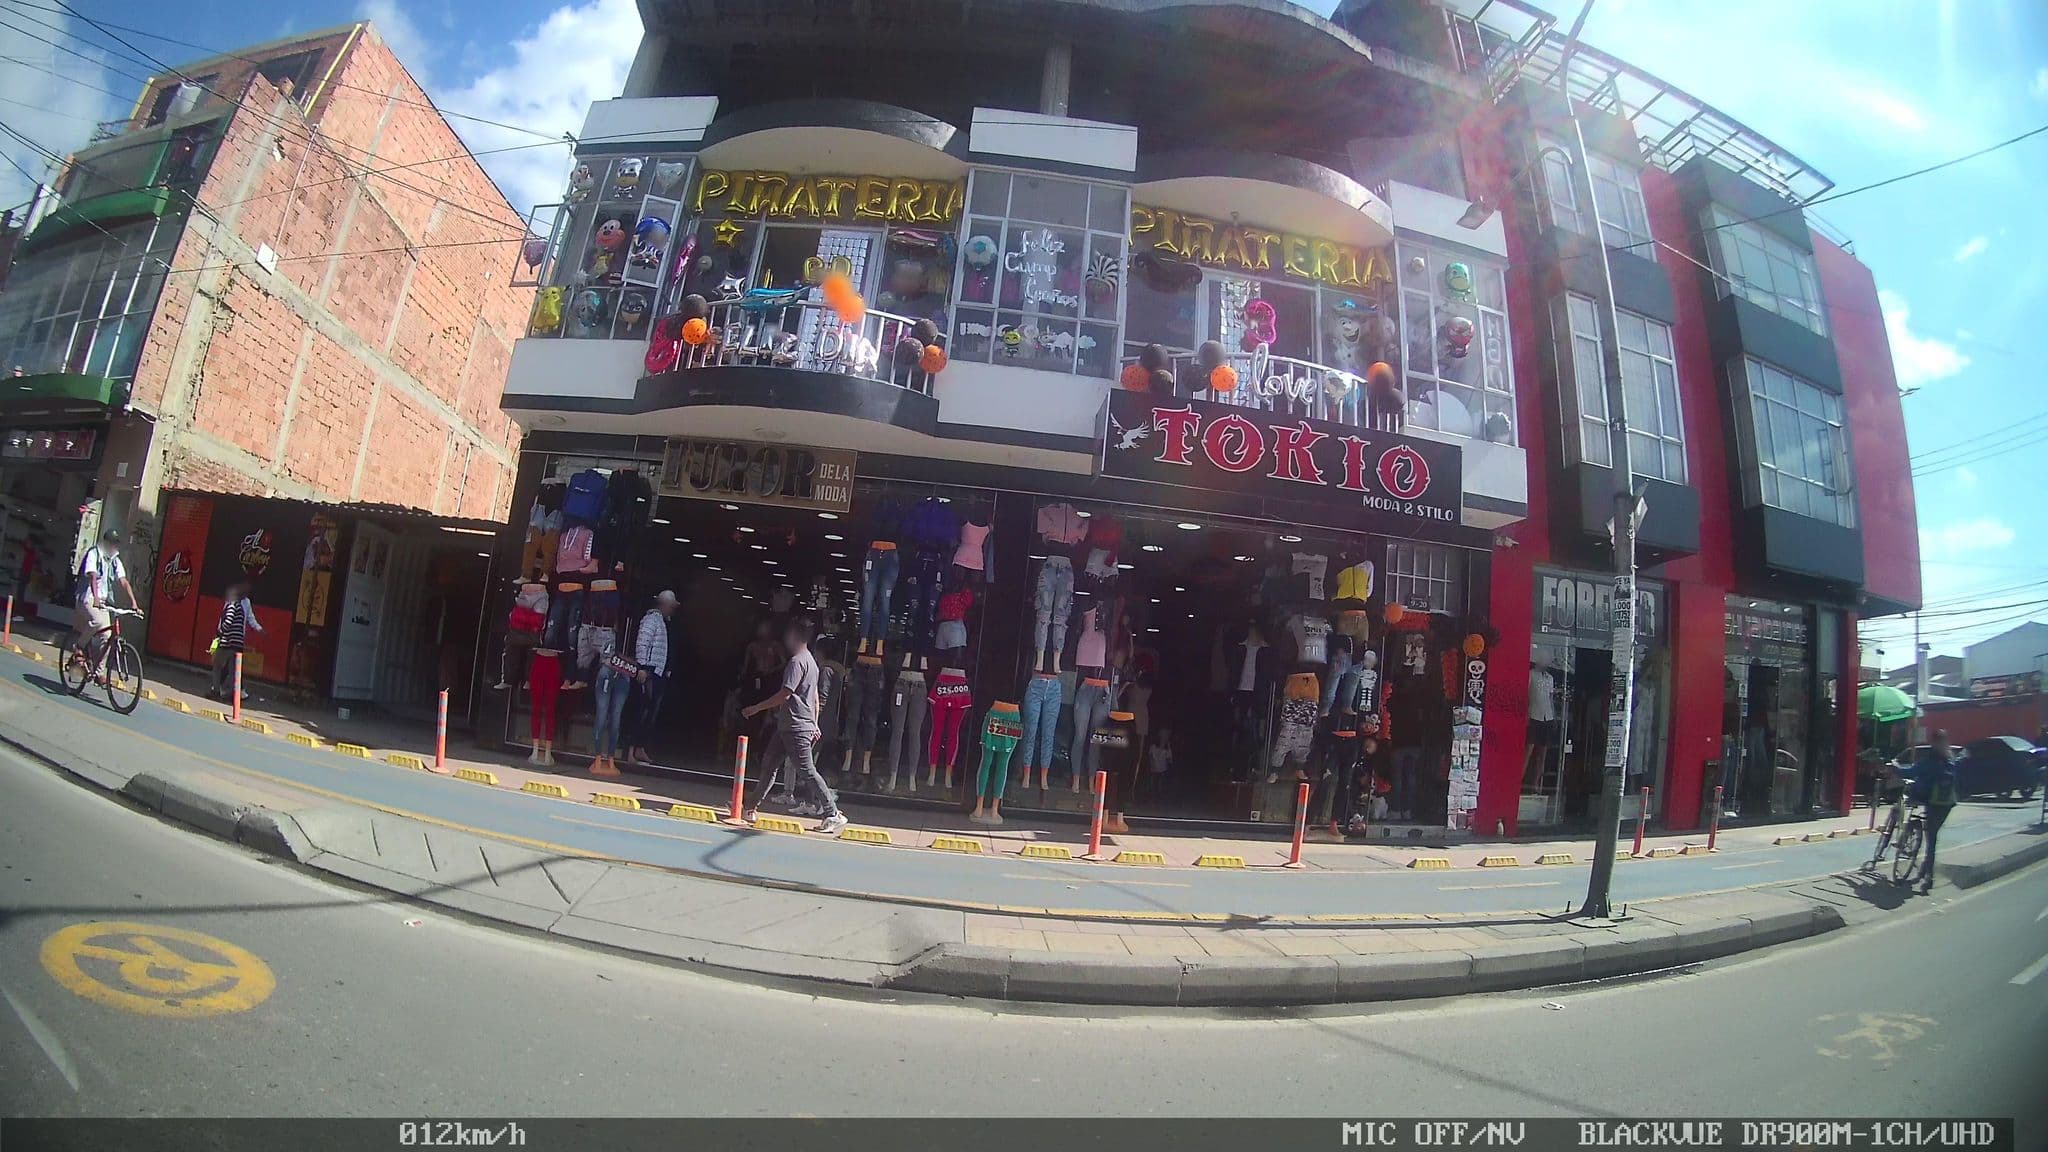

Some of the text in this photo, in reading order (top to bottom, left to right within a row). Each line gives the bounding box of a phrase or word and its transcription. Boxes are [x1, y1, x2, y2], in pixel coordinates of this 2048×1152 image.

[1250, 342, 1317, 406] love
[1151, 404, 1431, 500] TOKIO
[814, 484, 848, 503] MODA
[1363, 495, 1454, 521] MODA & STILO
